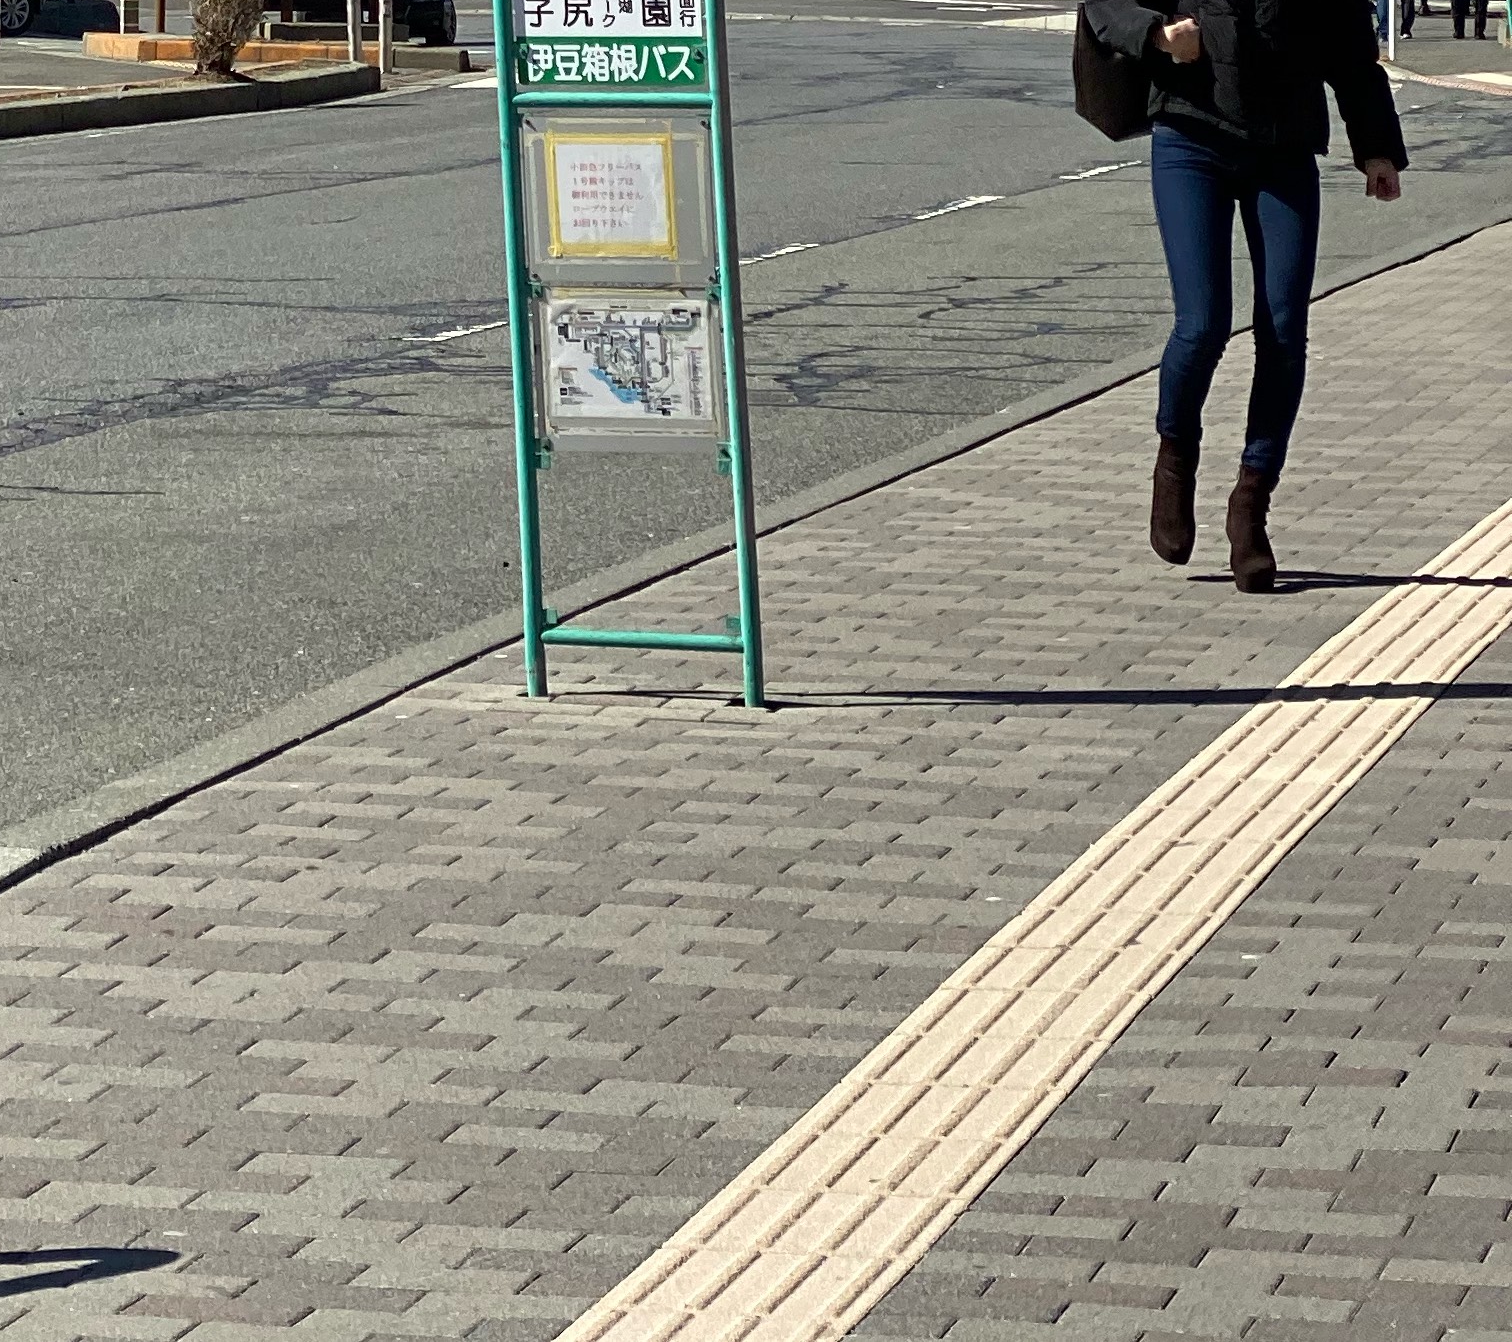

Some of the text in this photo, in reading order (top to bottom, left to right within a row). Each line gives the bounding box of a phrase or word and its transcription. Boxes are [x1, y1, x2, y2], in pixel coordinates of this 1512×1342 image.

[527, 43, 695, 82] 伊豆箱根バス
